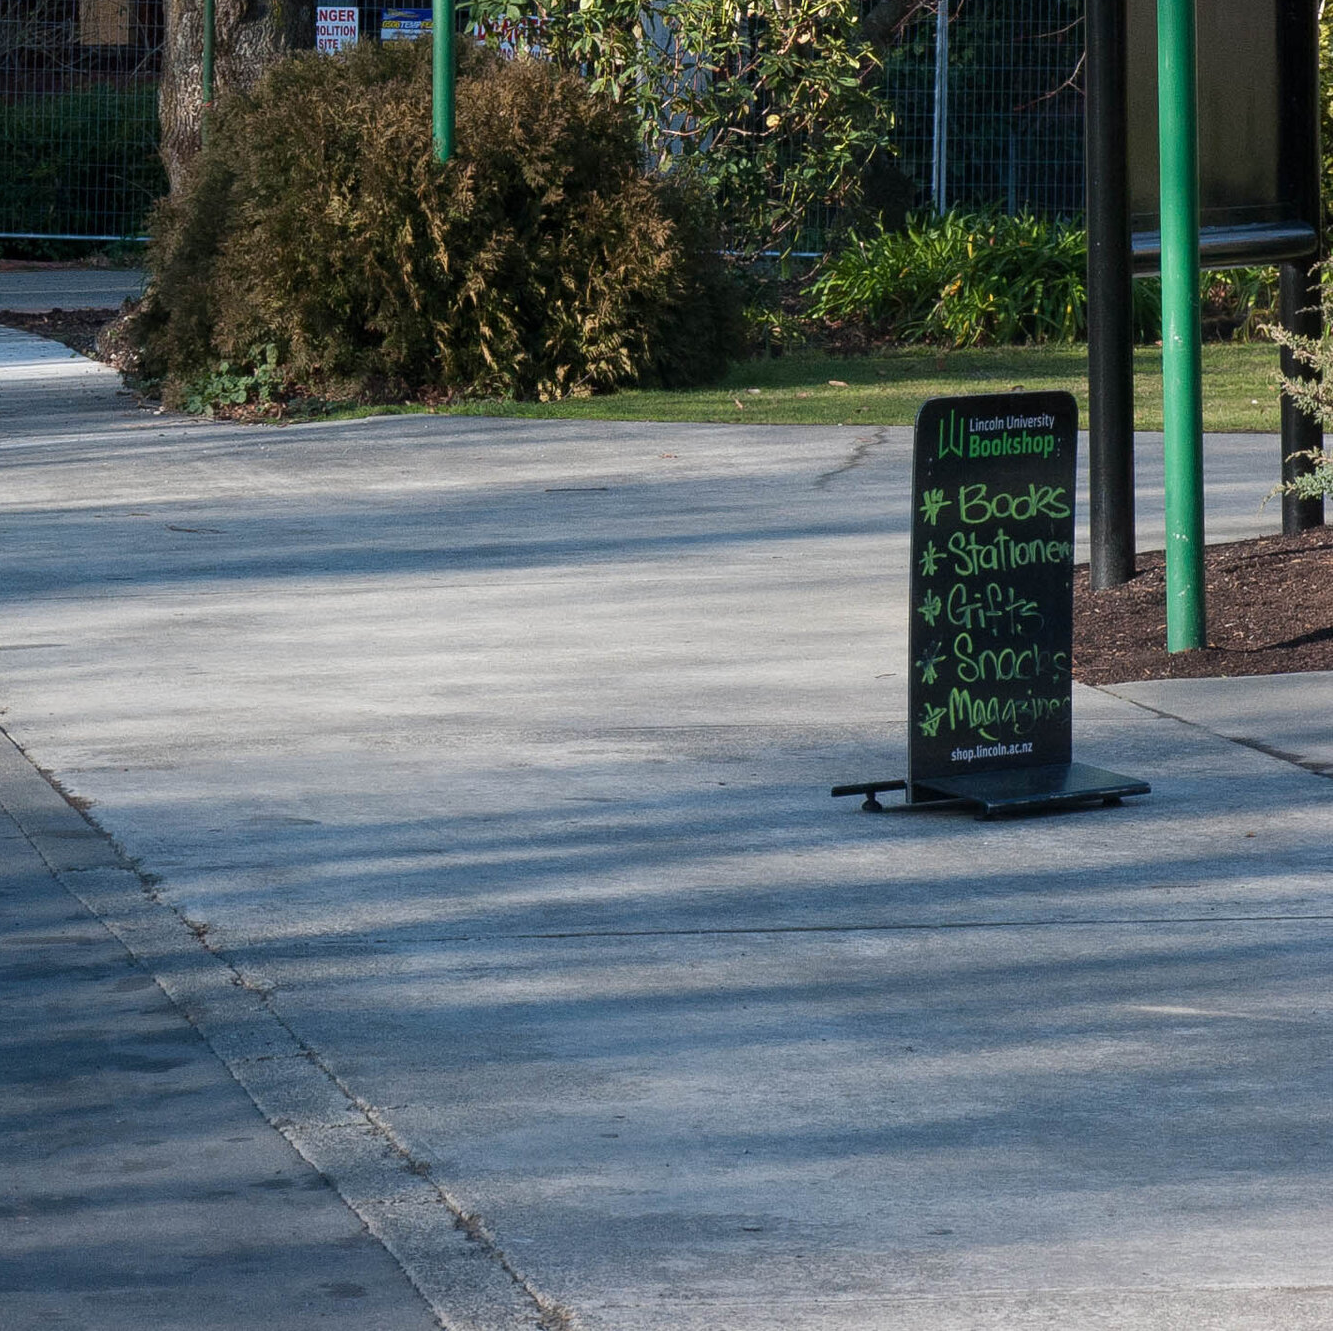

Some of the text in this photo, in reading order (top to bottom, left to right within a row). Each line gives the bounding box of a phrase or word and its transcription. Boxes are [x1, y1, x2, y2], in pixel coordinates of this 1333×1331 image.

[319, 38, 339, 49] SITE
[969, 414, 1055, 432] Lincoln University
[969, 430, 1055, 459] Bookshop
[959, 483, 1070, 524] Books
[947, 583, 1044, 636] Gifts
[954, 632, 1071, 683] Snacks
[951, 742, 1033, 763] shop.lincoln.ac.nz
